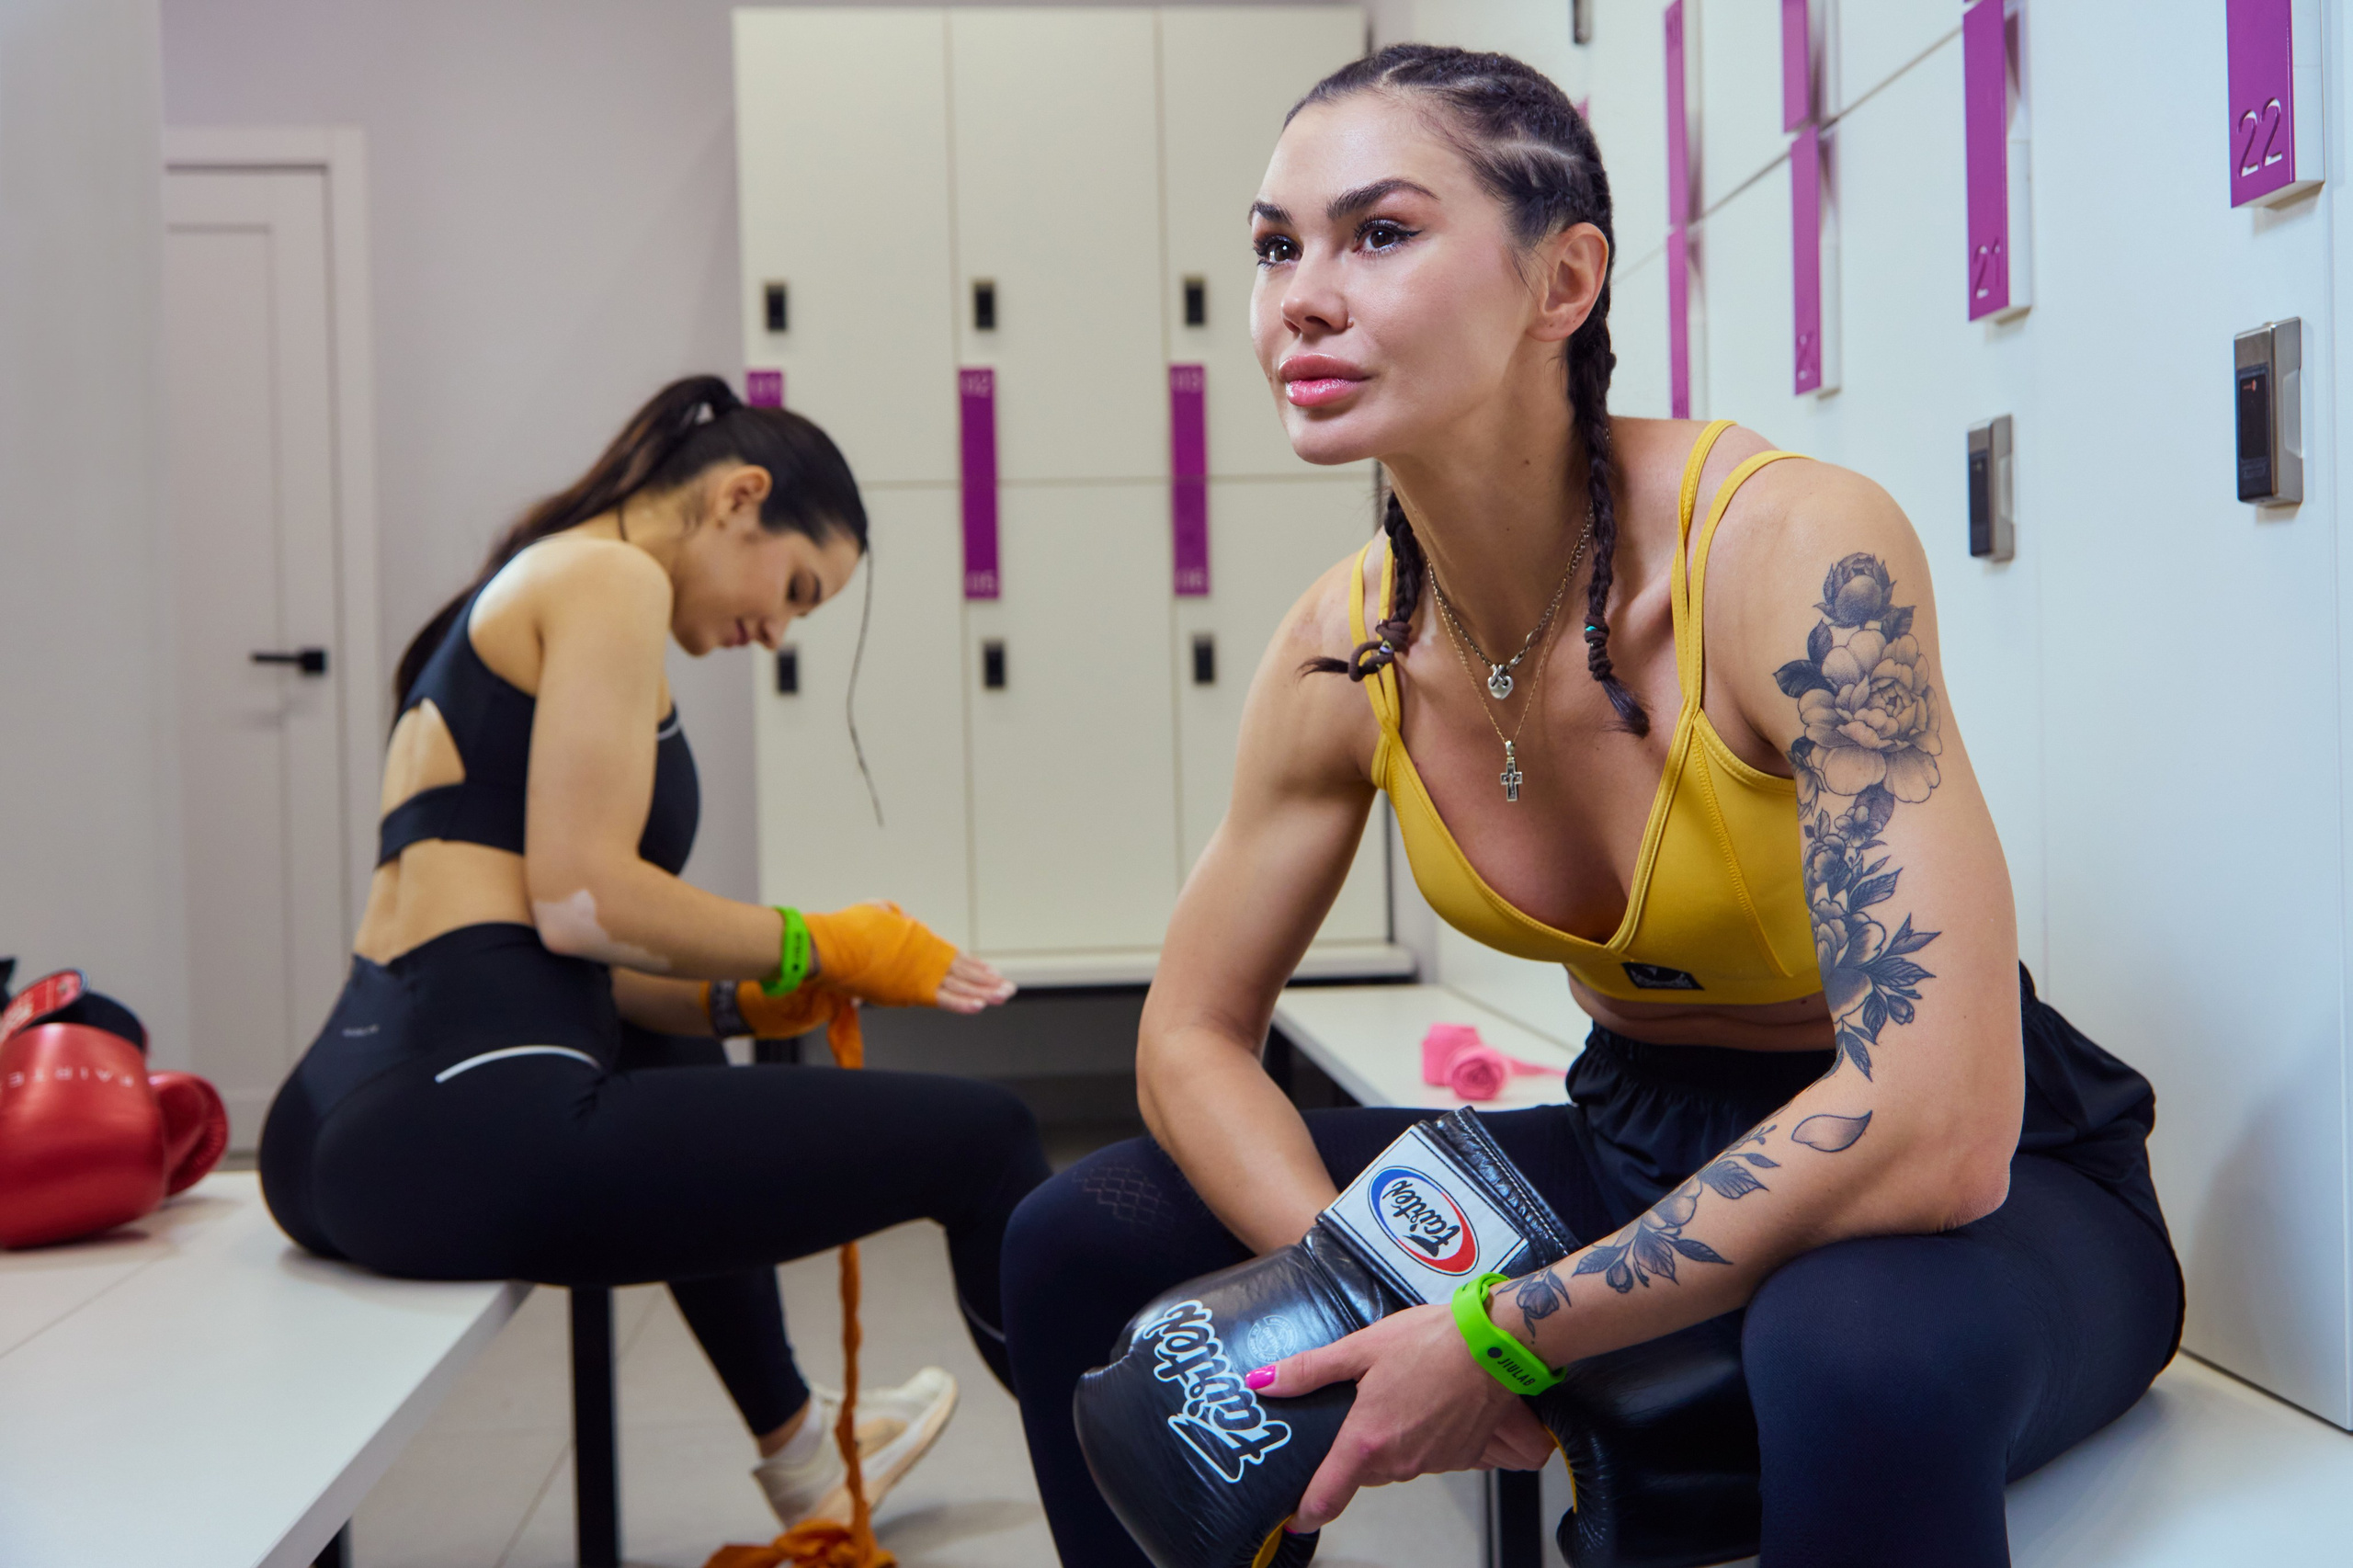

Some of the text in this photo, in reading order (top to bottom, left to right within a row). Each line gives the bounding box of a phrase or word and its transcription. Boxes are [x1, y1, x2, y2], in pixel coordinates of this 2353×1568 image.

[2237, 97, 2282, 178] 22
[1973, 236, 2001, 300] 21
[0, 1066, 135, 1093] FAIRTE
[1381, 1180, 1461, 1258] Fairtex
[1142, 1300, 1292, 1483] Fairtex
[1496, 1358, 1536, 1386] JIULAB
